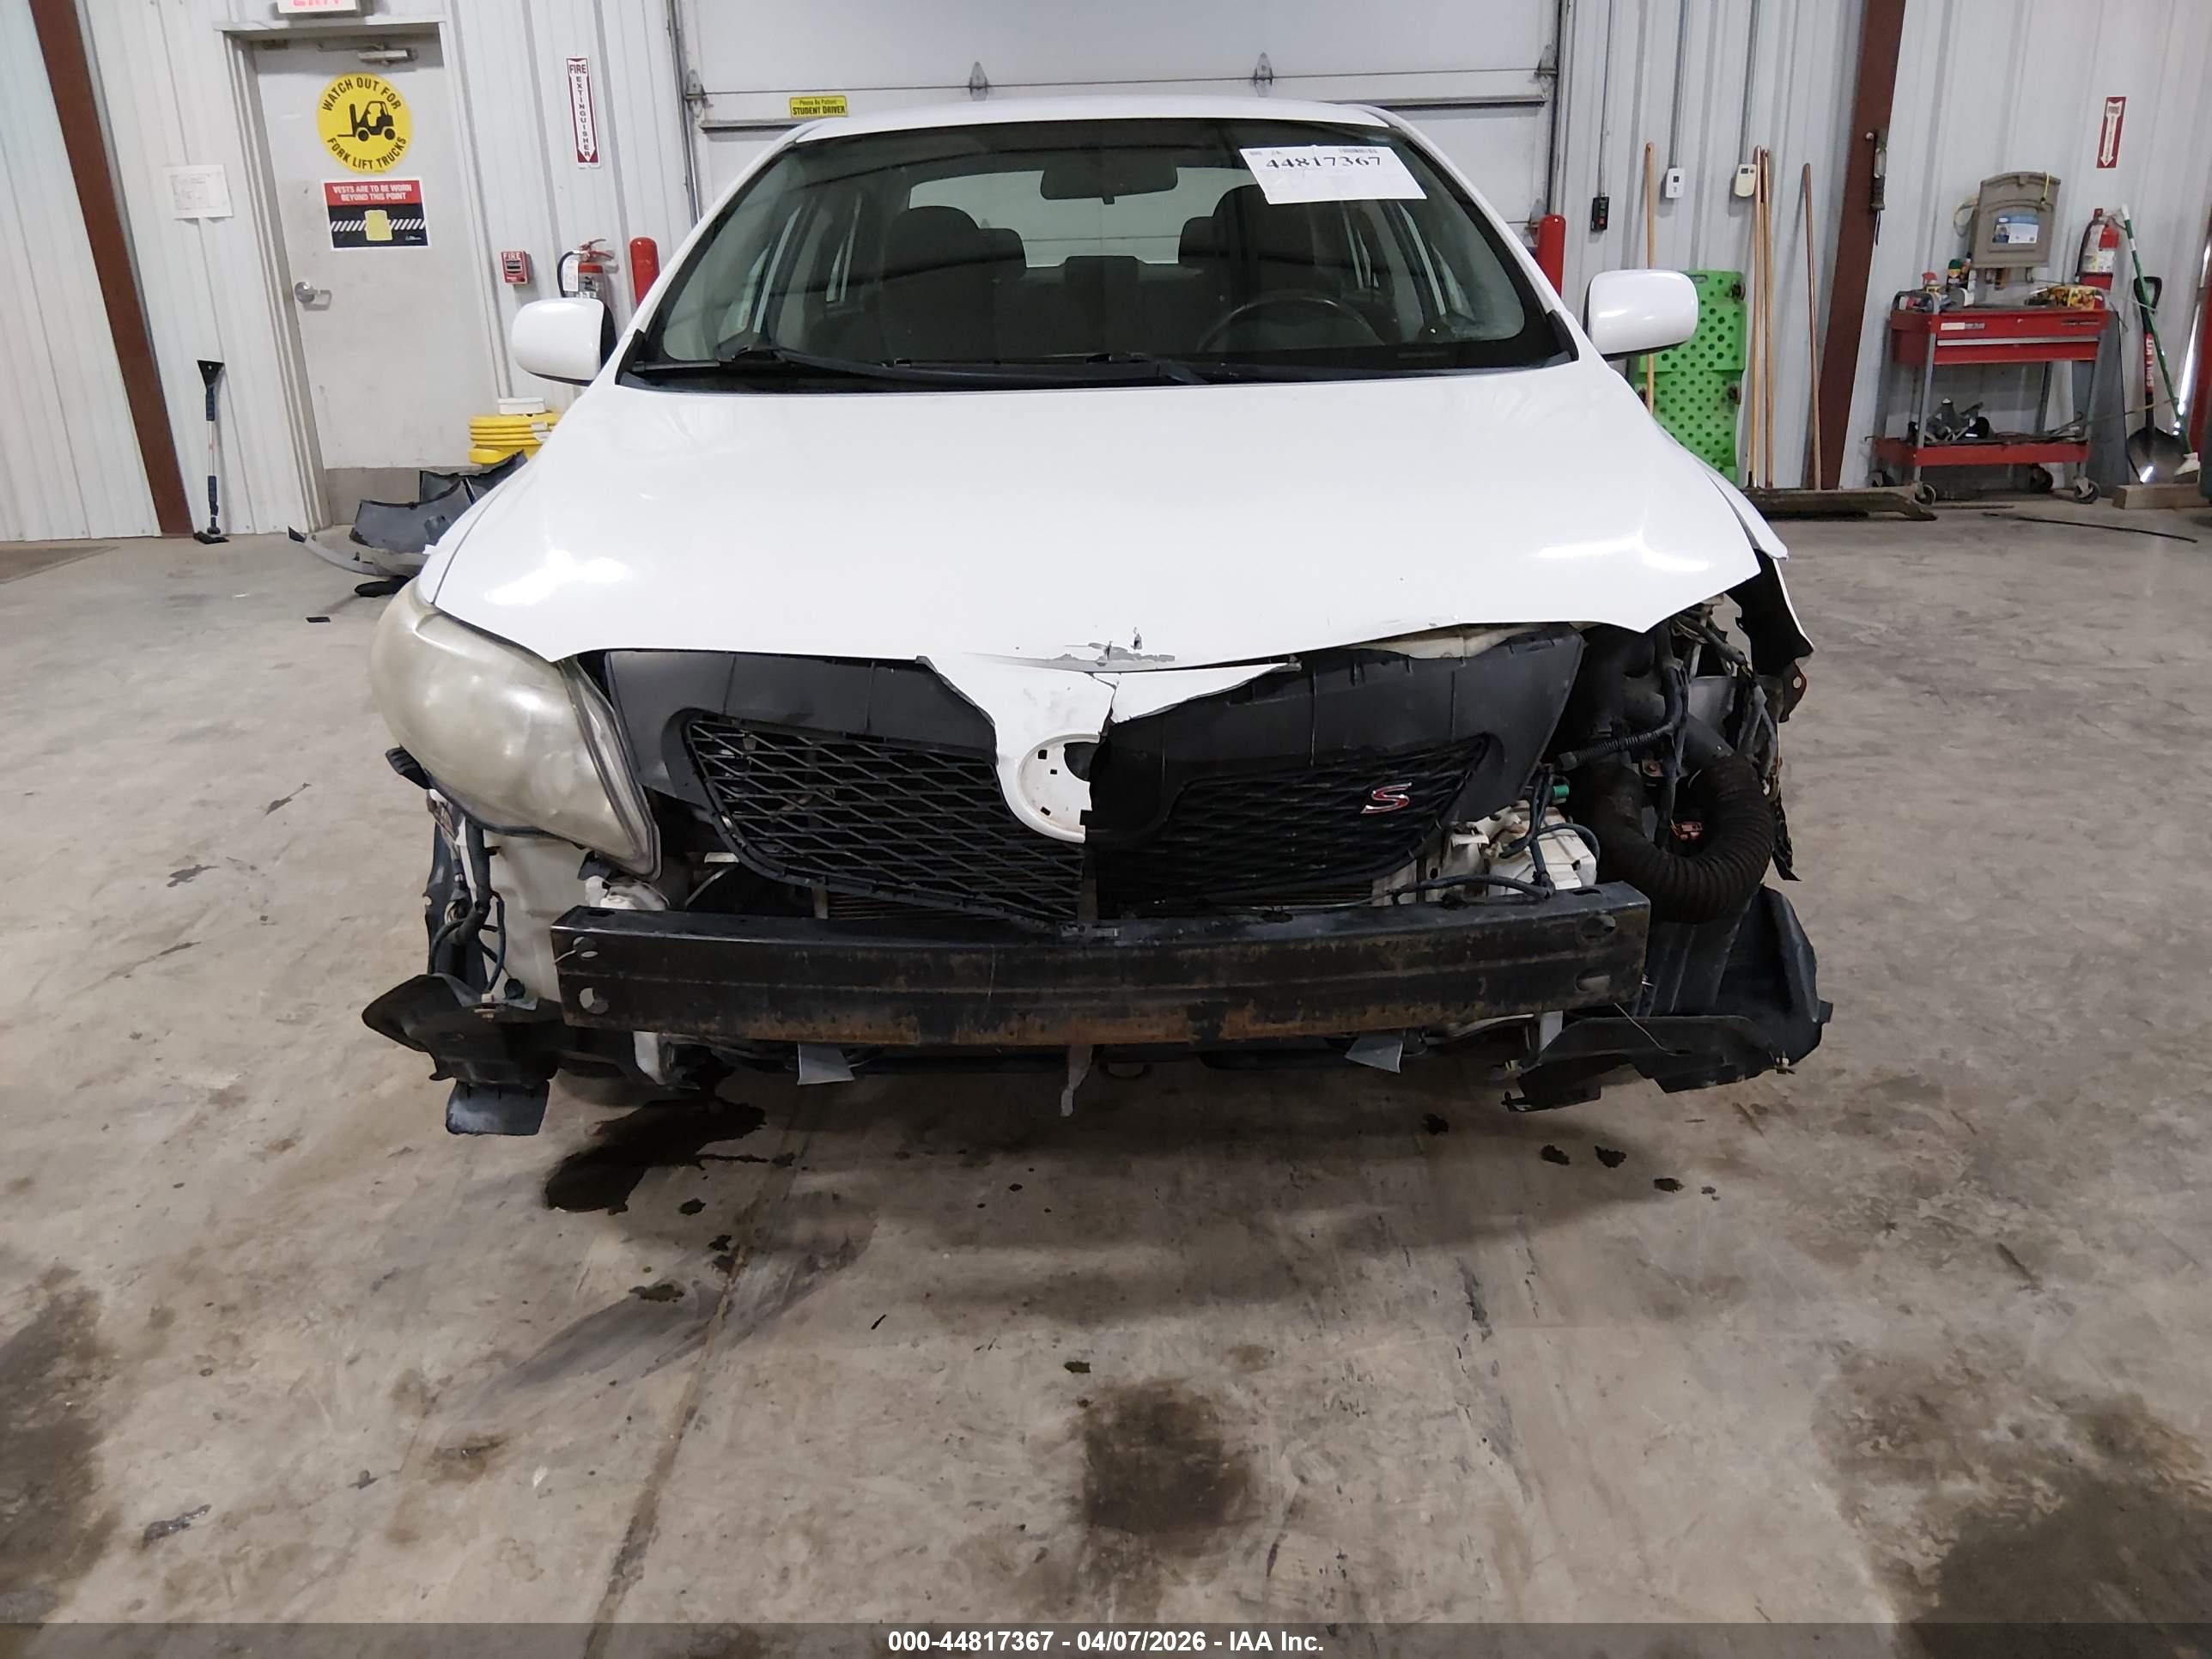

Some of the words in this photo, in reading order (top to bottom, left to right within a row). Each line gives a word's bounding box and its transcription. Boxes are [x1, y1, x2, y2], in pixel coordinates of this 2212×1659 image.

[569, 64, 586, 74] FIRE
[323, 78, 354, 112] WATCH
[356, 76, 380, 91] OUT
[380, 87, 401, 109] FOR
[576, 76, 591, 157] EXTINGUISHER
[793, 106, 820, 115] STUDENT
[823, 106, 845, 114] DRIVER
[327, 137, 350, 163] FORK
[353, 156, 373, 170] LIFT
[376, 137, 406, 168] TRUCKS
[1266, 156, 1381, 169] 44817367
[332, 185, 355, 194] VESTS
[356, 185, 368, 193] ARE
[380, 184, 390, 192] BE
[341, 193, 368, 202] BEYOND
[369, 192, 386, 201] THIS
[386, 191, 407, 200] POINT
[503, 252, 522, 261] FIRE
[1360, 782, 1413, 814] S
